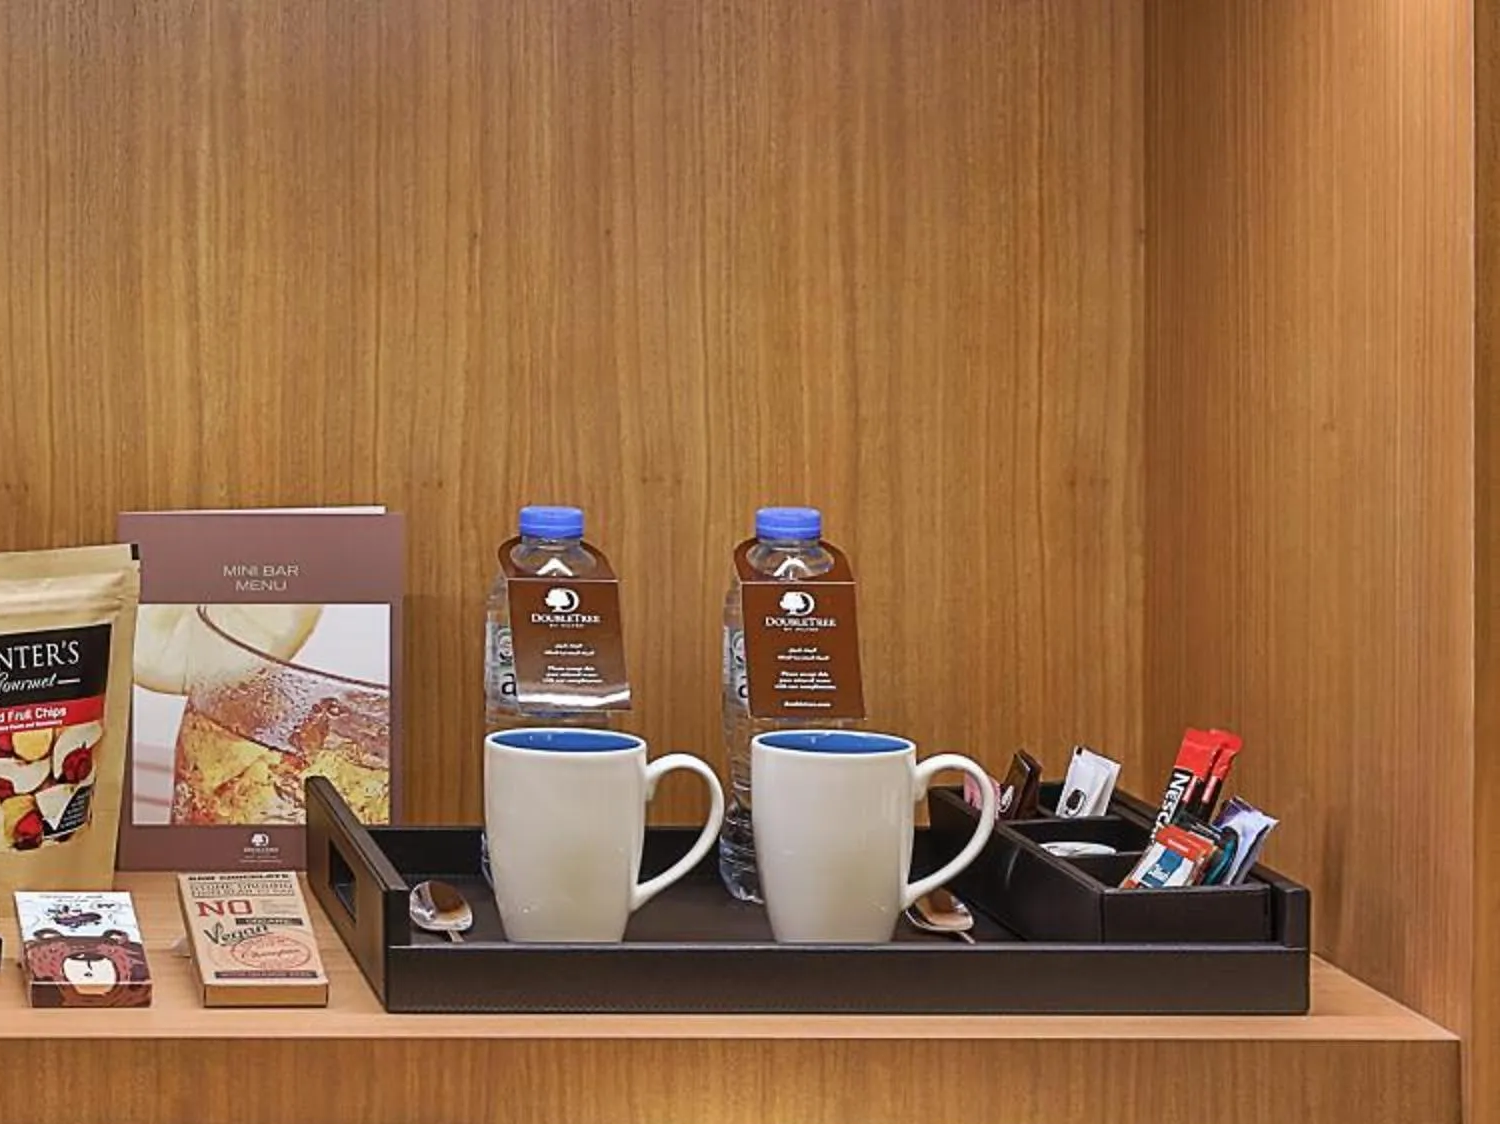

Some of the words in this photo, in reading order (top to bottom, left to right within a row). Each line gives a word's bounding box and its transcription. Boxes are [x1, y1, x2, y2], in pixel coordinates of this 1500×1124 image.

[223, 565, 259, 577] MINI
[262, 565, 299, 577] BAR
[235, 580, 287, 591] MENU
[7, 708, 33, 723] Fruit
[35, 706, 67, 720] Chips
[195, 899, 253, 917] NO
[203, 922, 268, 946] Vegan
